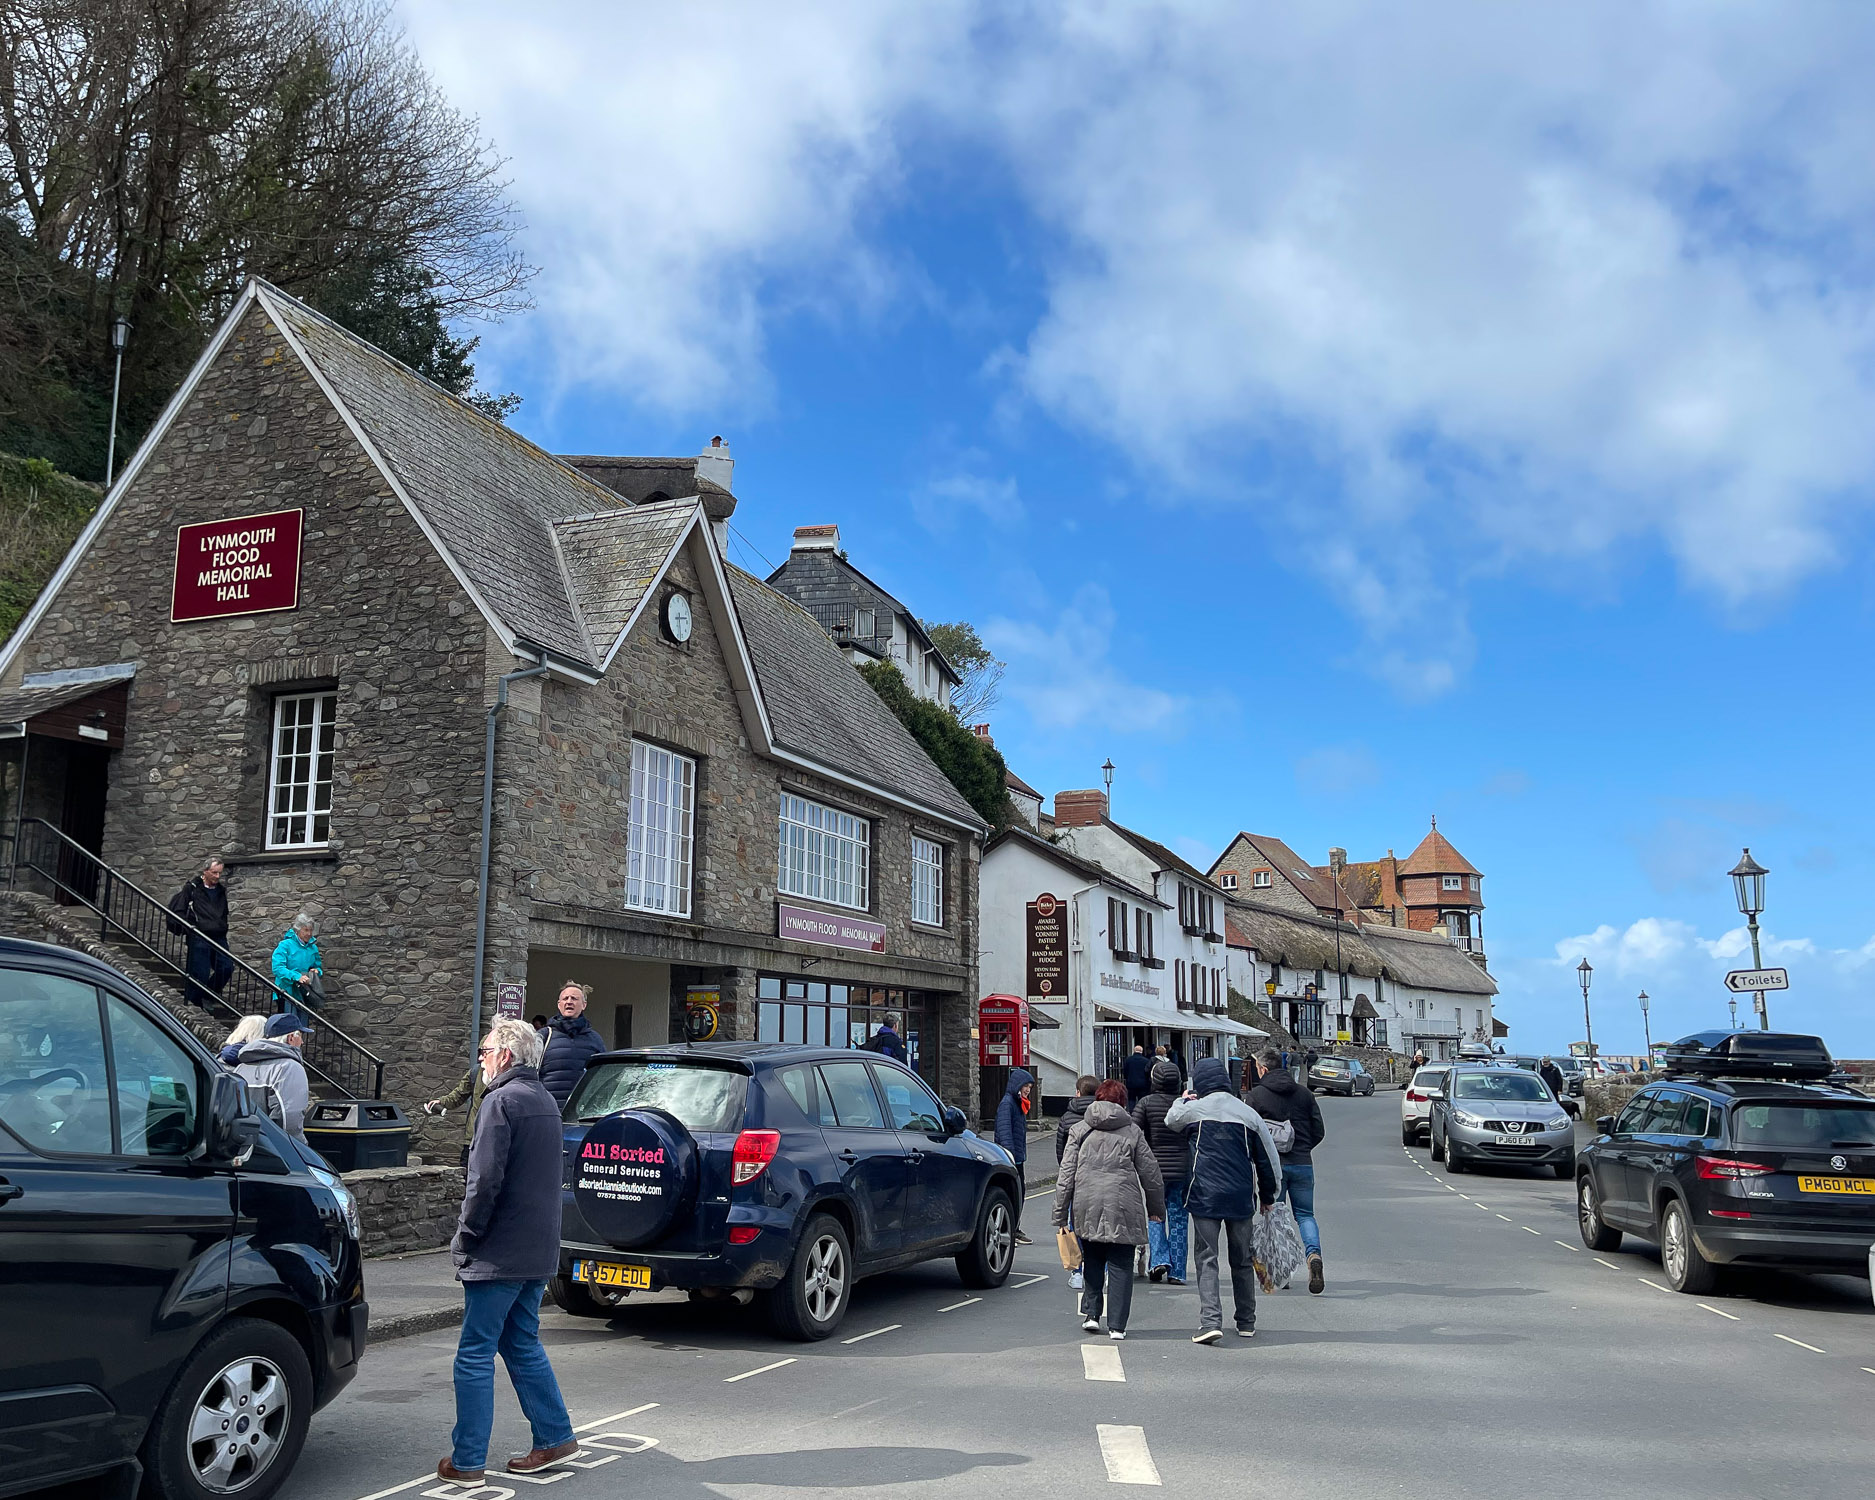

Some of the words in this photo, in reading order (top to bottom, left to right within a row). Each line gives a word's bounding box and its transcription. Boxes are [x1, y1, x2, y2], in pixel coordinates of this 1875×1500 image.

[200, 528, 276, 552] LYNMOUTH
[212, 547, 260, 567] FLOOD
[197, 563, 273, 587] MEMORIAL
[216, 583, 250, 602] HALL
[785, 916, 818, 933] LYNMOUTH
[818, 922, 838, 936] FLOOD
[840, 926, 869, 942] MEMORIAL
[869, 931, 881, 944] HALL
[1740, 975, 1782, 986] Toilets
[581, 1142, 606, 1159] All
[610, 1144, 665, 1164] Sorted
[583, 1162, 617, 1175] General
[620, 1165, 661, 1179] Services
[1804, 1178, 1841, 1191] PM60
[1843, 1180, 1872, 1192] MCL
[621, 1267, 648, 1286] EDL
